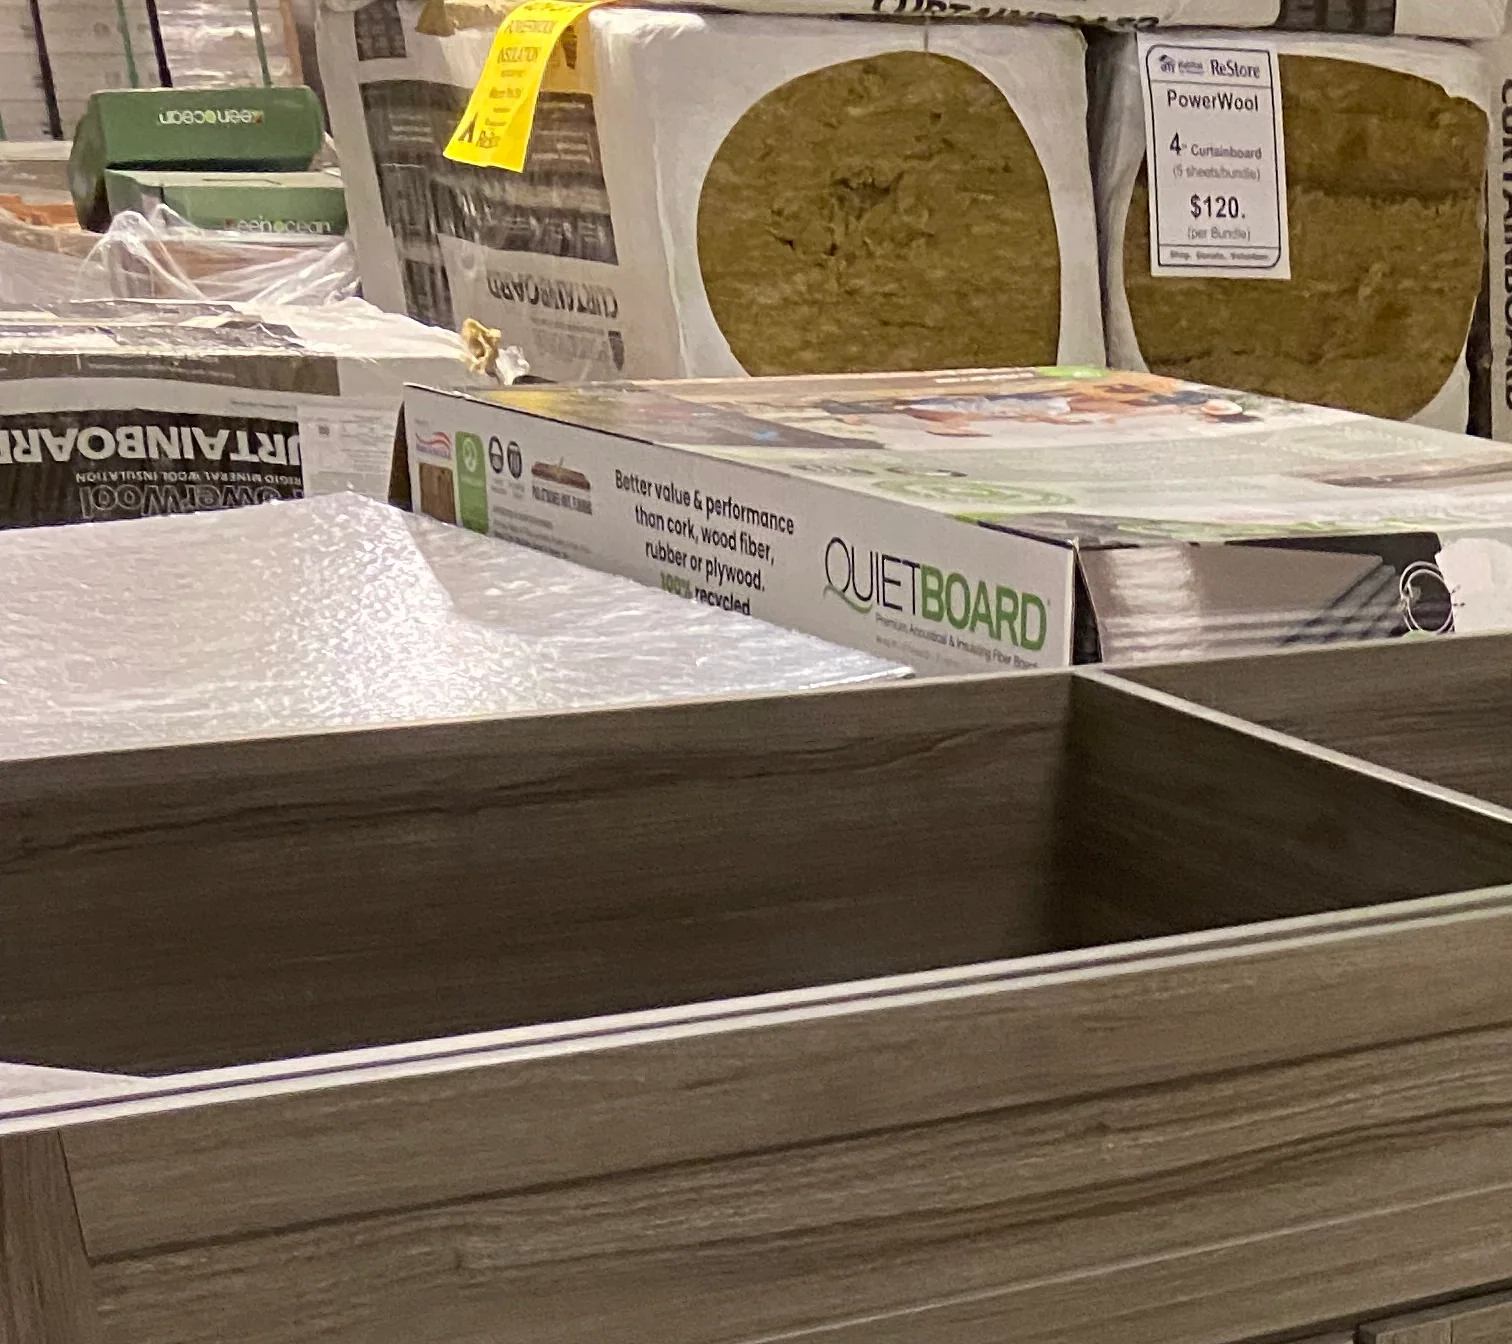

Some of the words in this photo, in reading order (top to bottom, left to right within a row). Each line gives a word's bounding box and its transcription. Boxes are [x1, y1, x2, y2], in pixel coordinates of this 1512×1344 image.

[1210, 59, 1260, 79] ReStore
[1167, 89, 1259, 112] PowerWool
[1191, 144, 1262, 160] Curtainboard
[1190, 193, 1246, 219] $120.
[78, 483, 303, 518] owerWool
[615, 469, 652, 497] Better
[655, 482, 691, 507] value
[694, 491, 703, 511] &
[706, 496, 794, 535] performance
[635, 505, 665, 531] than
[667, 517, 699, 544] cork,
[701, 526, 737, 551] wood
[740, 532, 775, 566] fiber,
[645, 541, 687, 567] rubber
[690, 555, 702, 572] or
[705, 558, 765, 592] plywood.
[695, 585, 751, 616] recycled
[824, 537, 1048, 651] QUIETBOARD
